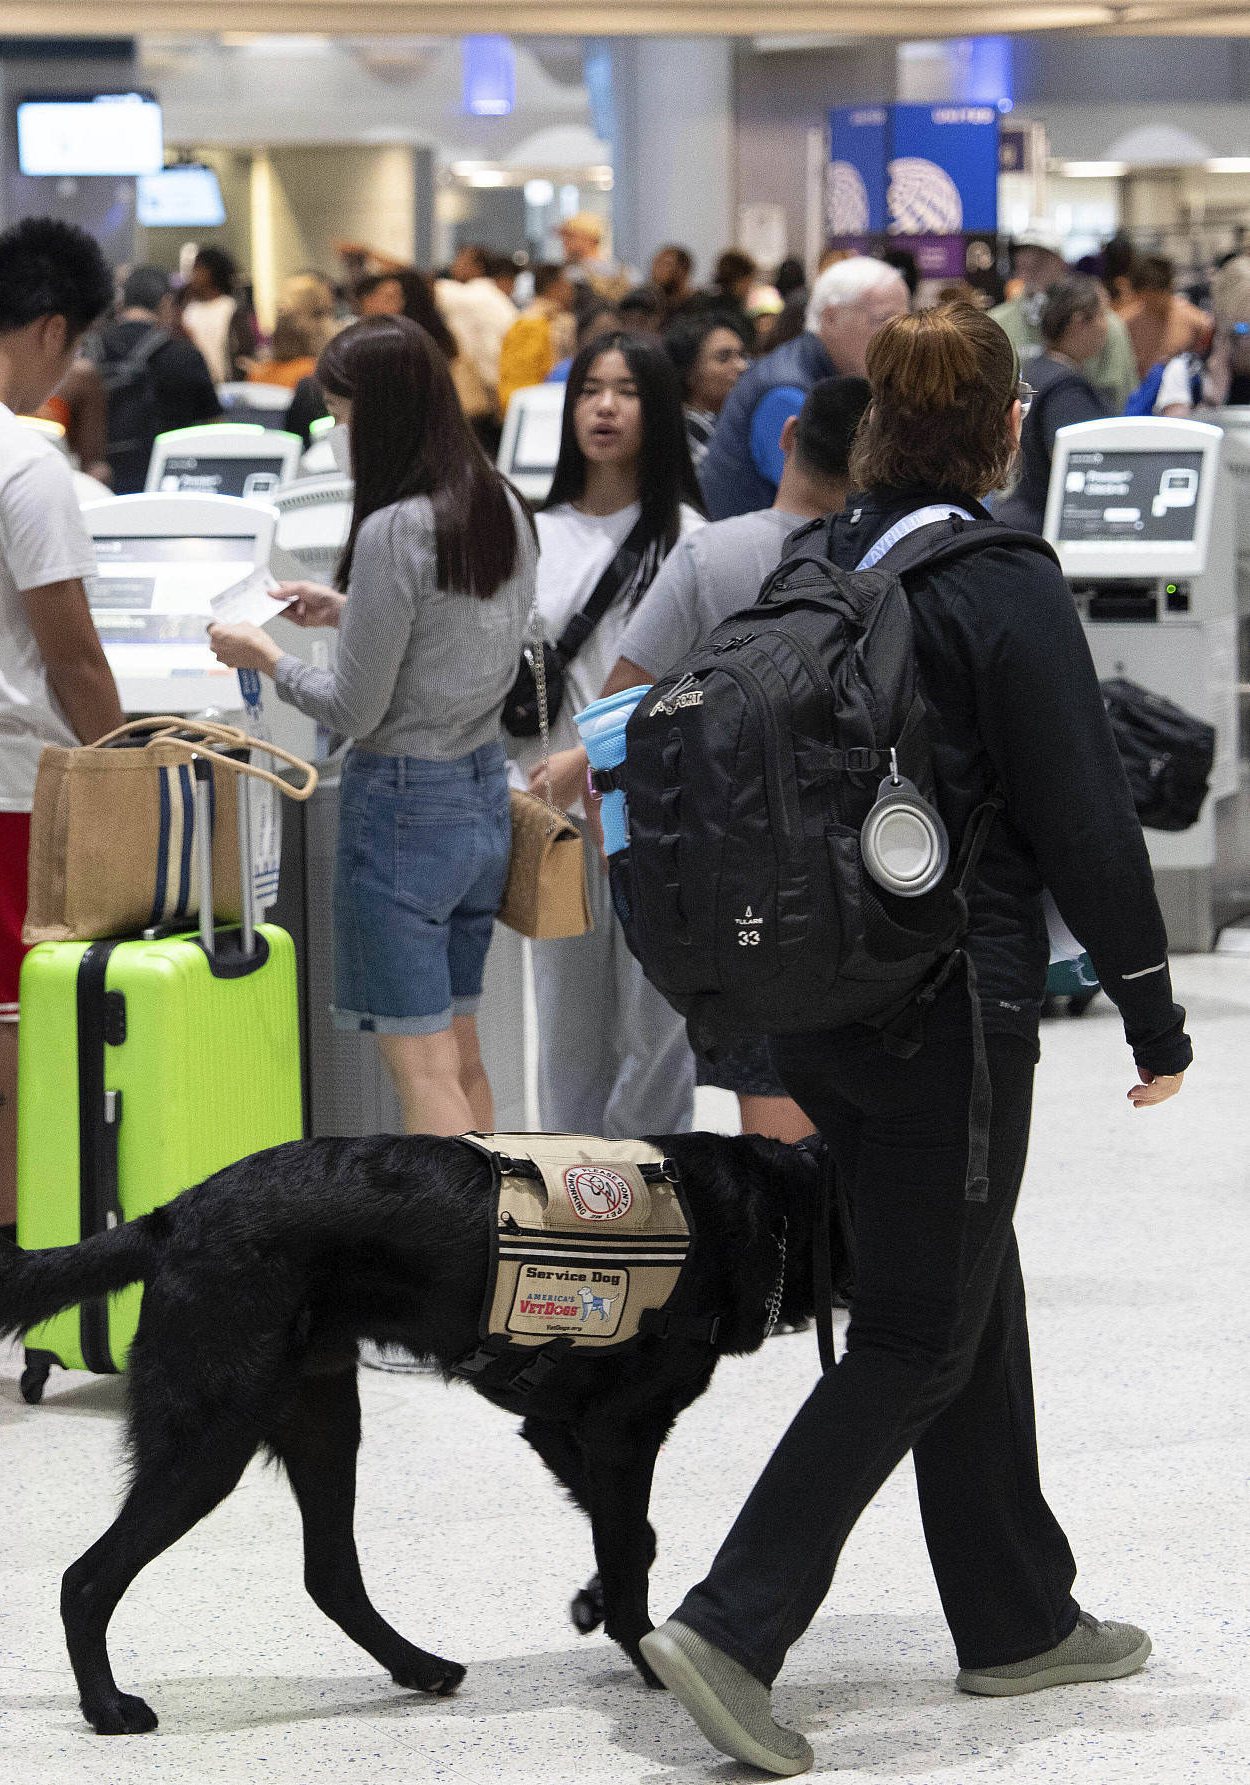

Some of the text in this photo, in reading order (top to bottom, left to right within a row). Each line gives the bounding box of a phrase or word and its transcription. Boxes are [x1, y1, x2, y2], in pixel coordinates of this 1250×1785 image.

[735, 917, 763, 925] TULARE
[738, 930, 761, 946] 33
[581, 1168, 617, 1180] PLEASE
[567, 1178, 587, 1216] WORKING
[617, 1181, 629, 1208] DON'T
[606, 1207, 623, 1219] PET
[526, 1267, 621, 1286] Service Dog
[526, 1293, 575, 1303] AMERICA'S
